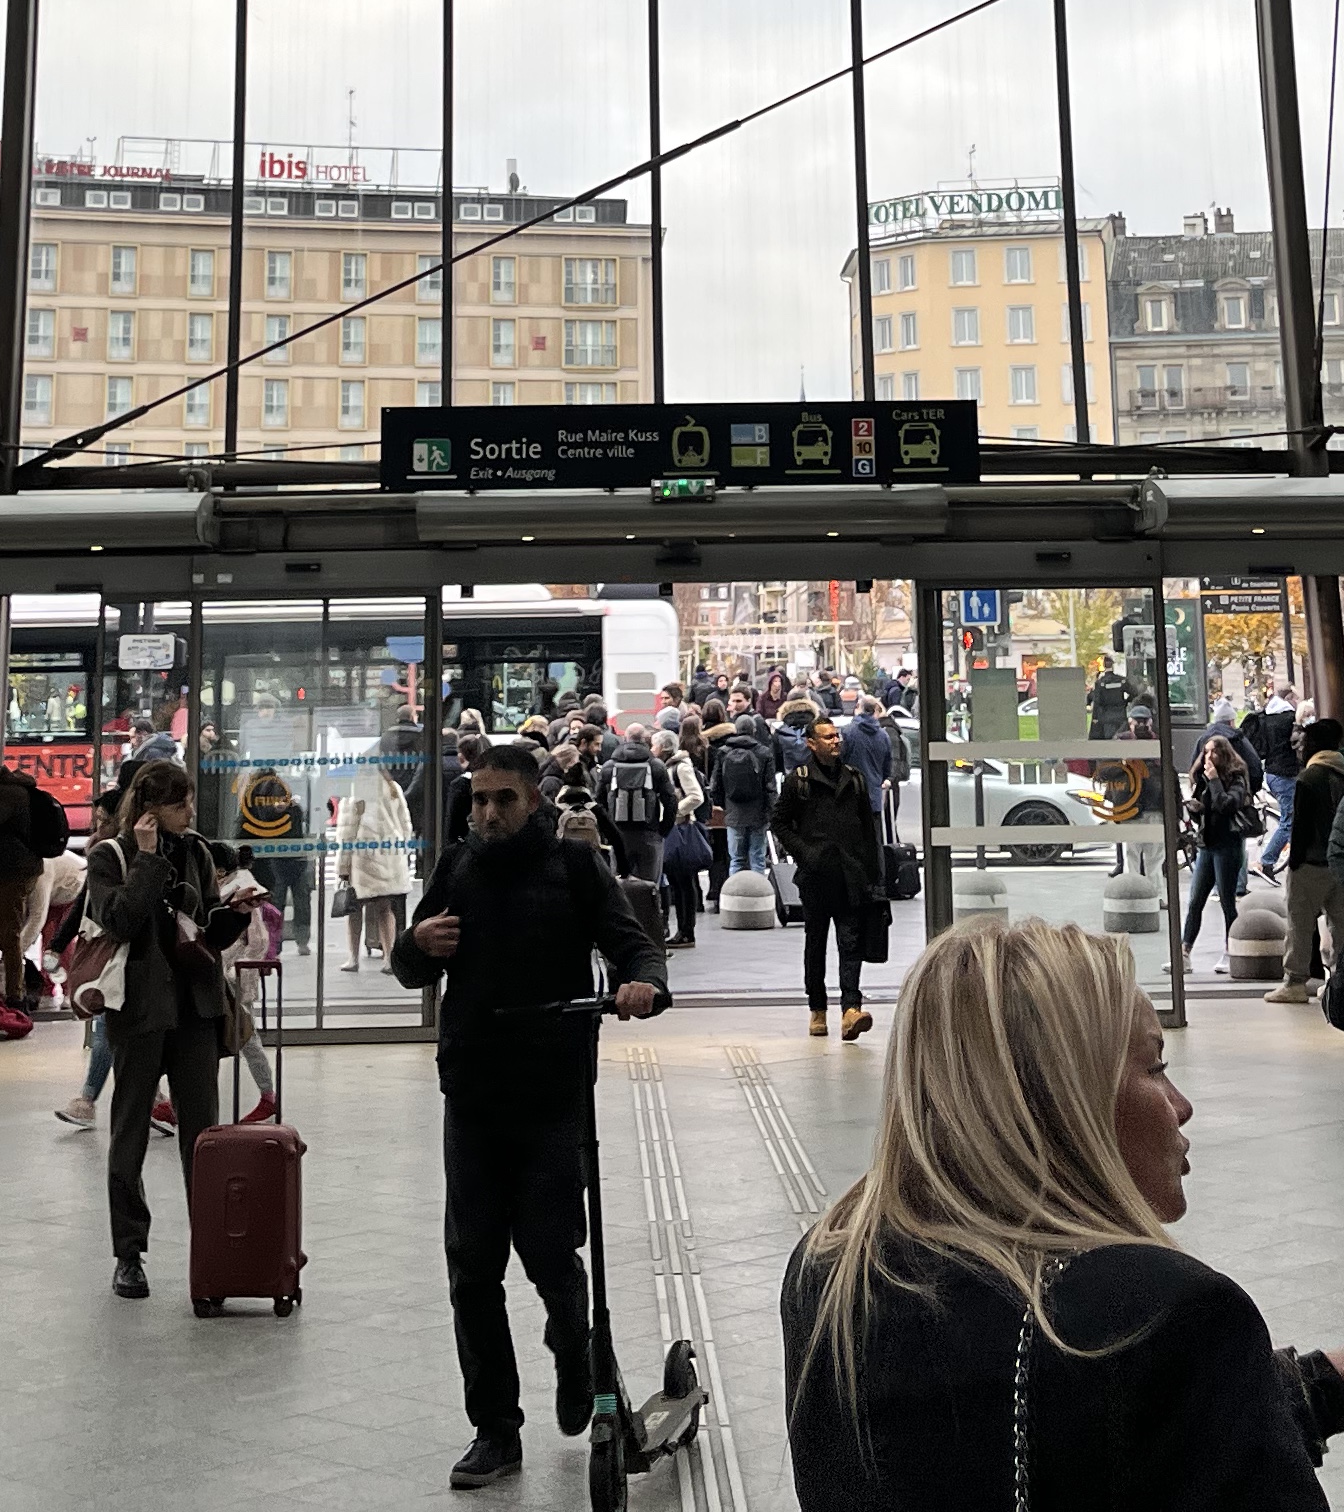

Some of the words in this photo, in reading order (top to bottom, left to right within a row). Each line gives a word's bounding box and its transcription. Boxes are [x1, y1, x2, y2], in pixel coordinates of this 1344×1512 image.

[259, 152, 308, 179] ibis
[316, 165, 372, 182] HOTEL
[801, 412, 823, 423] Bus
[892, 410, 919, 421] Cars
[921, 409, 945, 420] TER
[558, 430, 584, 442] Rue
[587, 429, 625, 442] Maire
[628, 429, 660, 442] Kuss
[858, 422, 869, 436] 2
[470, 438, 542, 460] Sortie
[558, 446, 603, 459] Centre
[607, 445, 636, 459] ville
[856, 441, 873, 455] 10
[857, 460, 871, 474] G
[470, 467, 494, 480] Exit
[505, 467, 557, 482] Ausgang
